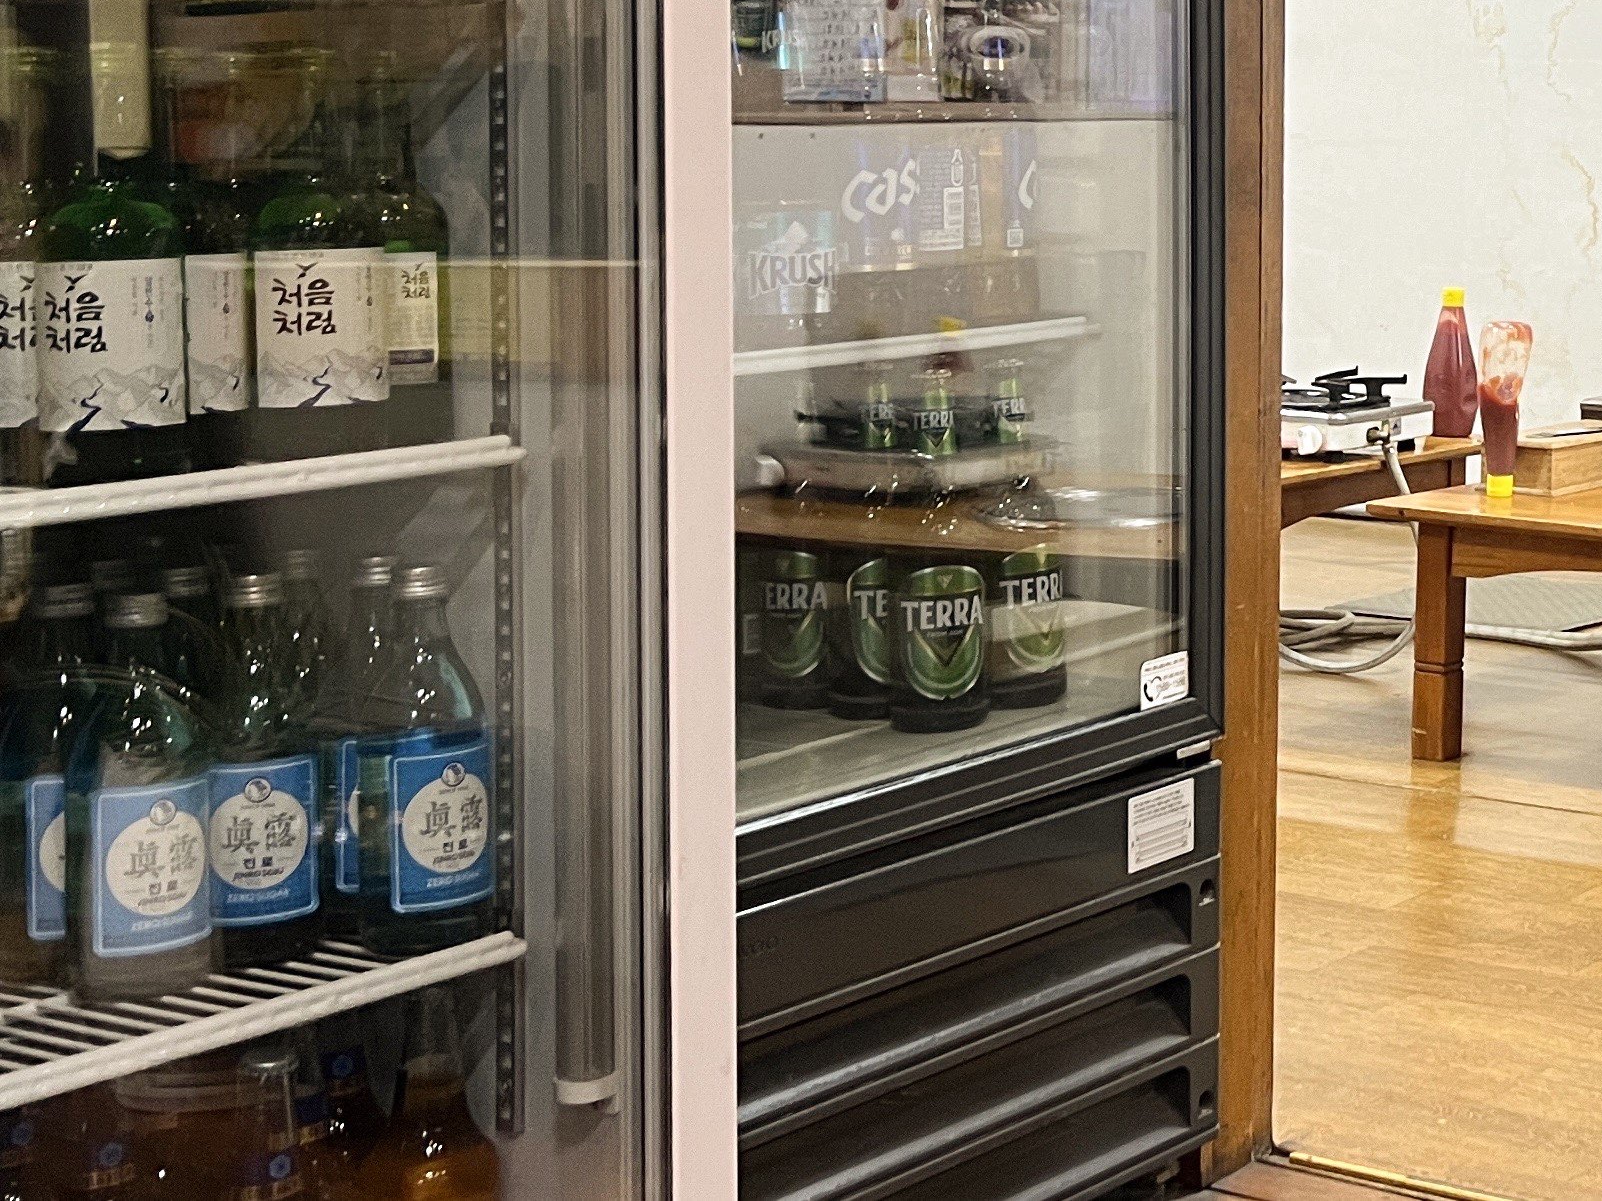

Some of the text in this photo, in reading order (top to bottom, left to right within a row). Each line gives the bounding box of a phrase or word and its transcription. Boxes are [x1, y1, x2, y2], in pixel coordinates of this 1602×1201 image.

[0, 293, 37, 322] 처
[45, 291, 105, 323] 처음
[272, 278, 335, 308] 처음
[272, 309, 337, 336] 처럼
[0, 325, 37, 352] 처
[45, 325, 108, 354] 처럼
[764, 581, 828, 610] ERRA
[1000, 572, 1063, 609] TERR
[900, 594, 984, 632] TERRA
